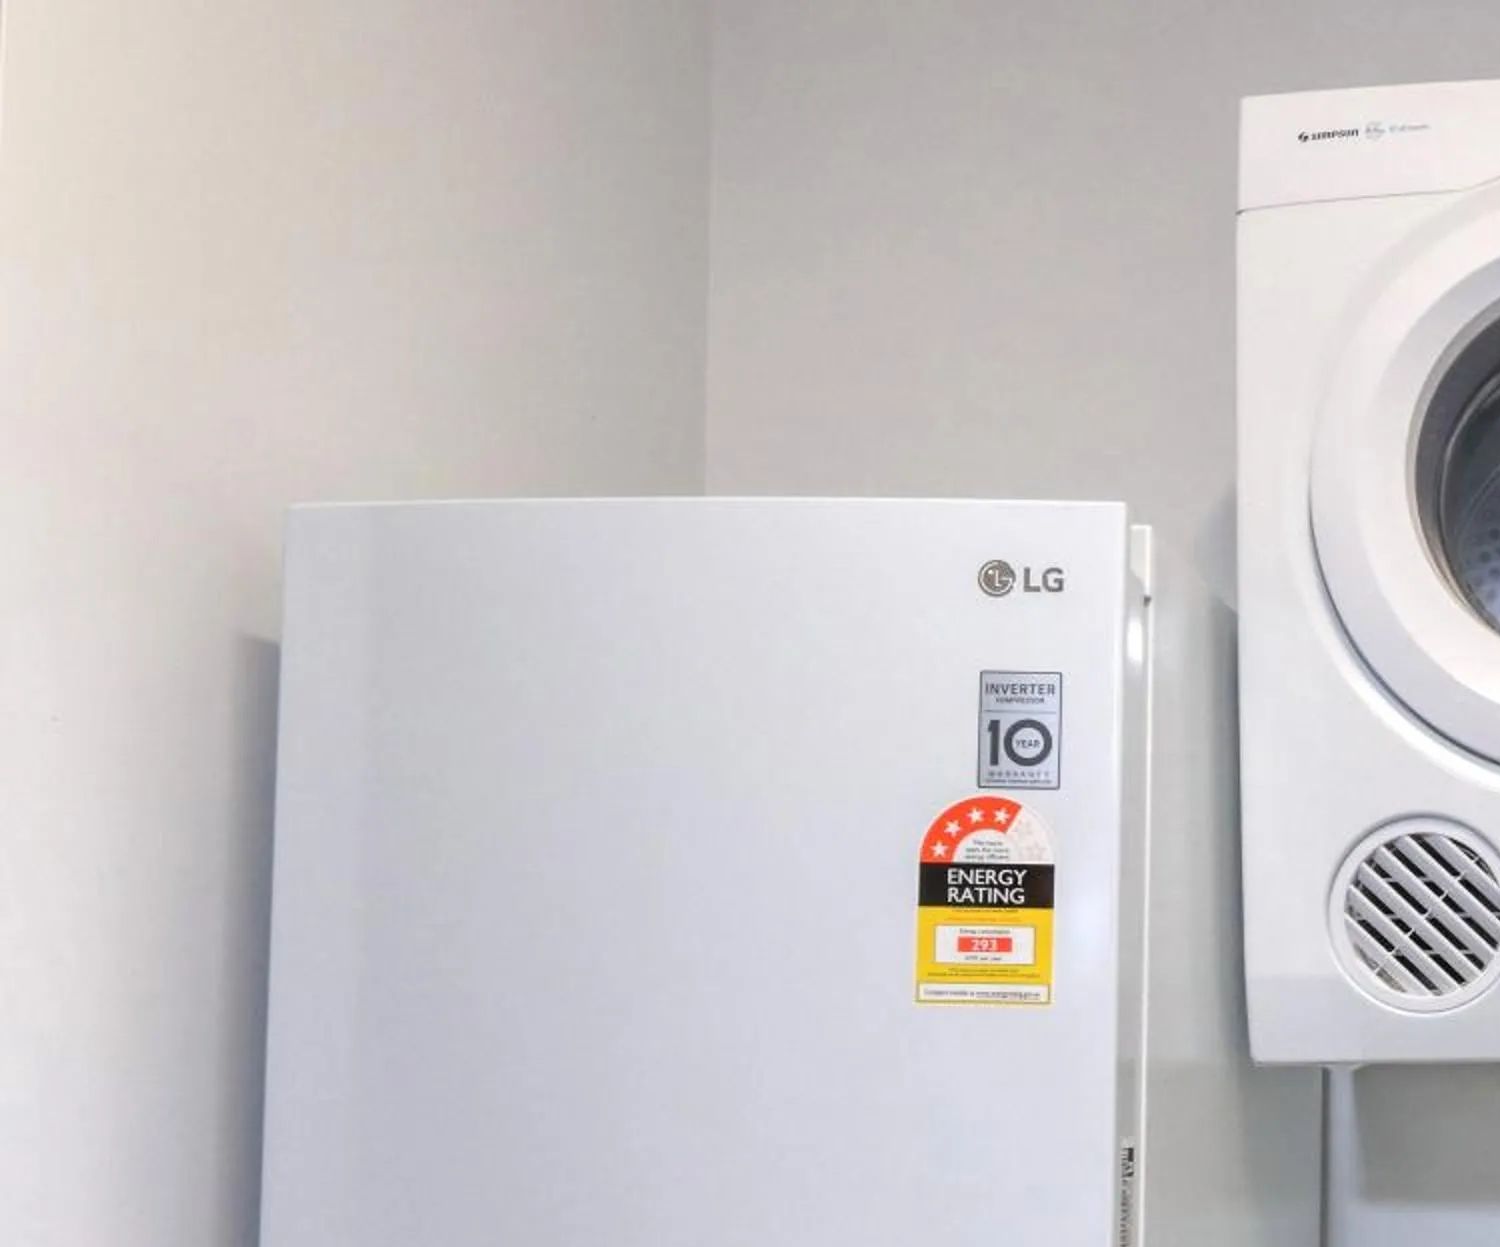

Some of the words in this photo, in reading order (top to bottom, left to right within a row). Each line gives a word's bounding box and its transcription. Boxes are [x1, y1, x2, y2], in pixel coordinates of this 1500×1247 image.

[1023, 566, 1065, 593] LG
[985, 683, 1055, 695] INVERTER
[987, 718, 1052, 767] 10
[1015, 739, 1040, 749] YEAR
[947, 868, 1028, 886] ENERGY
[947, 887, 1025, 905] RATING
